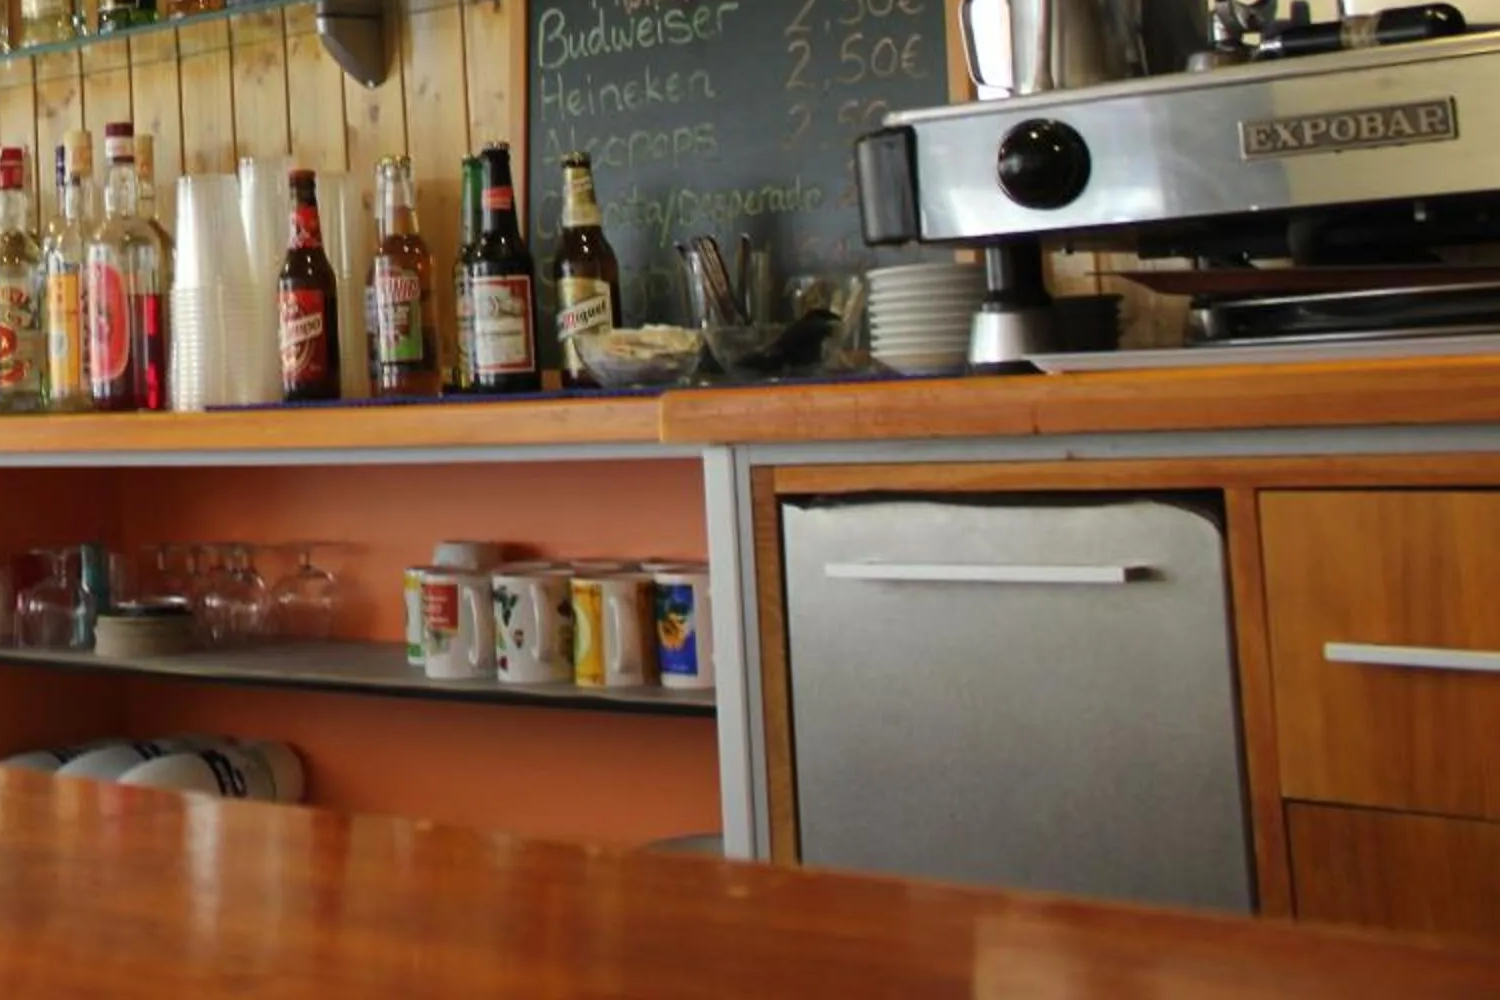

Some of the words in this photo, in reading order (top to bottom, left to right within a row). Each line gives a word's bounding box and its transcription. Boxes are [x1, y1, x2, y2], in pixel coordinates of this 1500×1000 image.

[538, 2, 739, 69] Budweiser
[540, 64, 716, 120] Heineken
[1248, 104, 1448, 151] EXPOBAR
